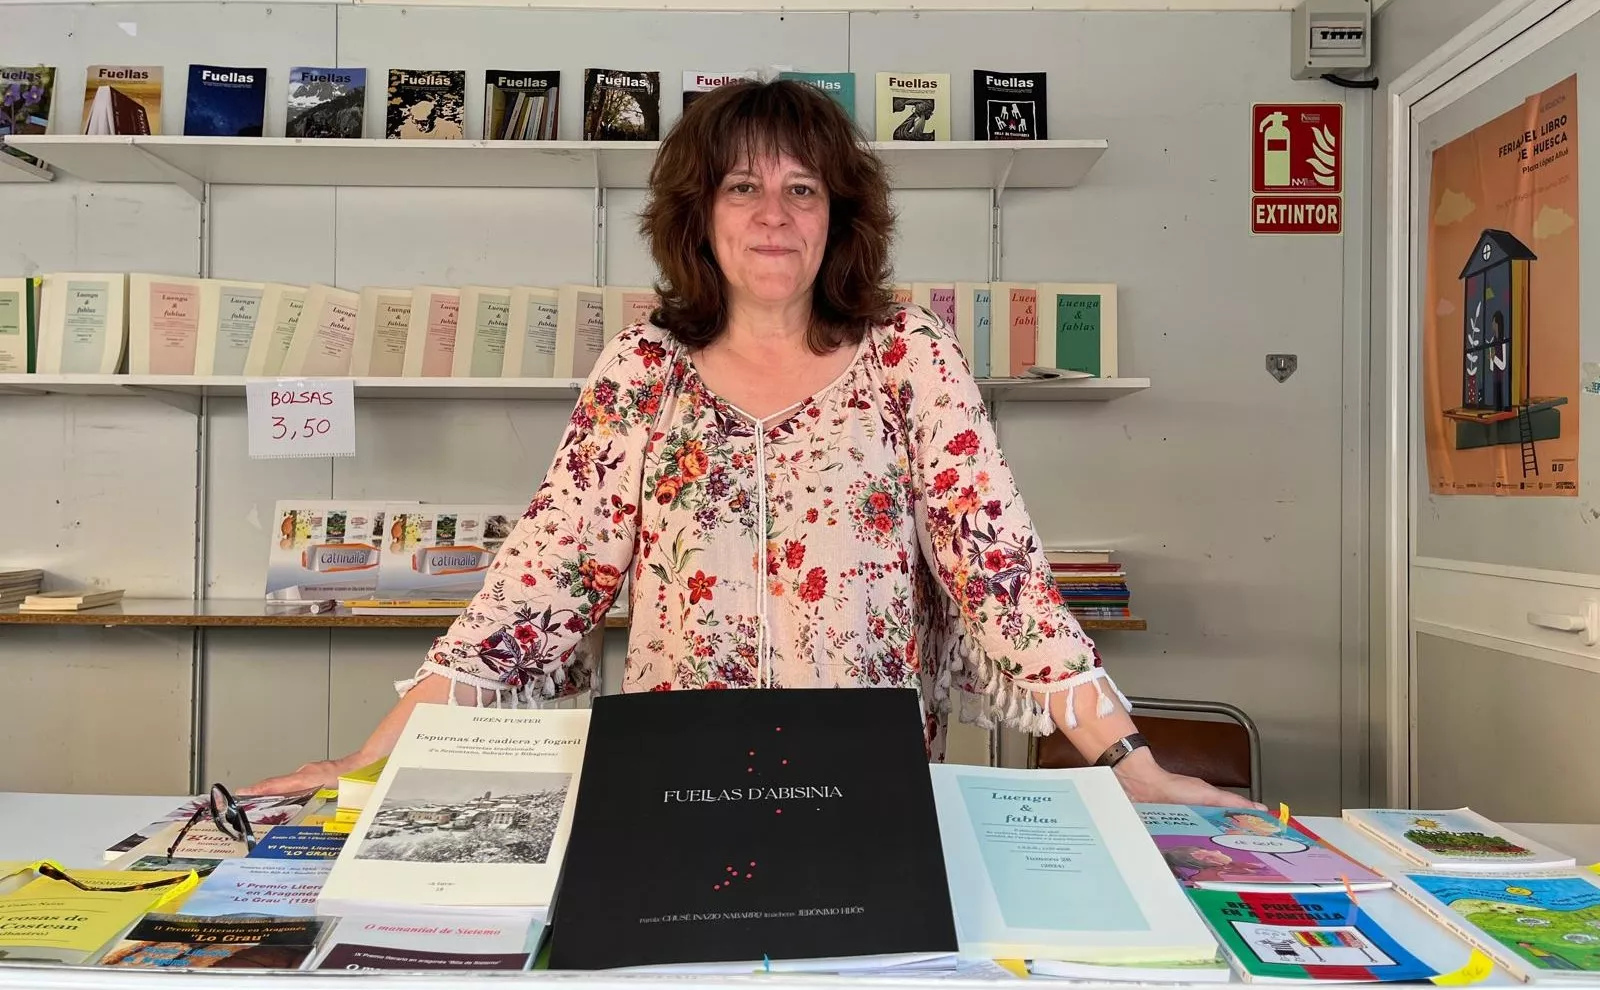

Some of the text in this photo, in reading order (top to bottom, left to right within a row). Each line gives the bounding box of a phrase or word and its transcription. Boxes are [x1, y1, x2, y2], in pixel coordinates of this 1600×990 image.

[99, 69, 149, 79] Fuellas
[202, 70, 254, 83] Fuellas
[301, 72, 351, 83] Fuellas
[400, 75, 451, 86] Fuellas
[498, 76, 548, 88] Fuellas
[597, 74, 647, 87] Fuellas
[889, 77, 938, 89] Fuellas
[986, 75, 1034, 88] Fuellas
[1498, 140, 1521, 158] FERIA
[1540, 115, 1568, 137] LIBRO
[1533, 132, 1568, 157] HUESCA
[1256, 204, 1338, 225] EXTINTOR
[1058, 298, 1099, 310] Luenga
[1073, 311, 1082, 320] &
[1060, 322, 1096, 332] fablas
[271, 391, 334, 406] BOLSAS
[271, 416, 331, 441] 3,50
[416, 733, 469, 743] Espurnas
[488, 737, 531, 745] cadiera
[543, 738, 581, 746] fogaril
[664, 785, 843, 803] FUELLAS D'ABISINIA
[992, 792, 1052, 803] Luenga
[1020, 804, 1032, 812] &
[1005, 814, 1058, 824] fablas
[264, 890, 319, 898] Aragonés
[1261, 903, 1323, 912] PUESTO
[8, 914, 89, 922] cosas de
[1265, 911, 1345, 920] PANTALLA
[1, 922, 79, 930] Costean
[378, 925, 438, 934] manantial
[439, 926, 452, 934] de
[191, 933, 270, 942] "Lo Grau"
